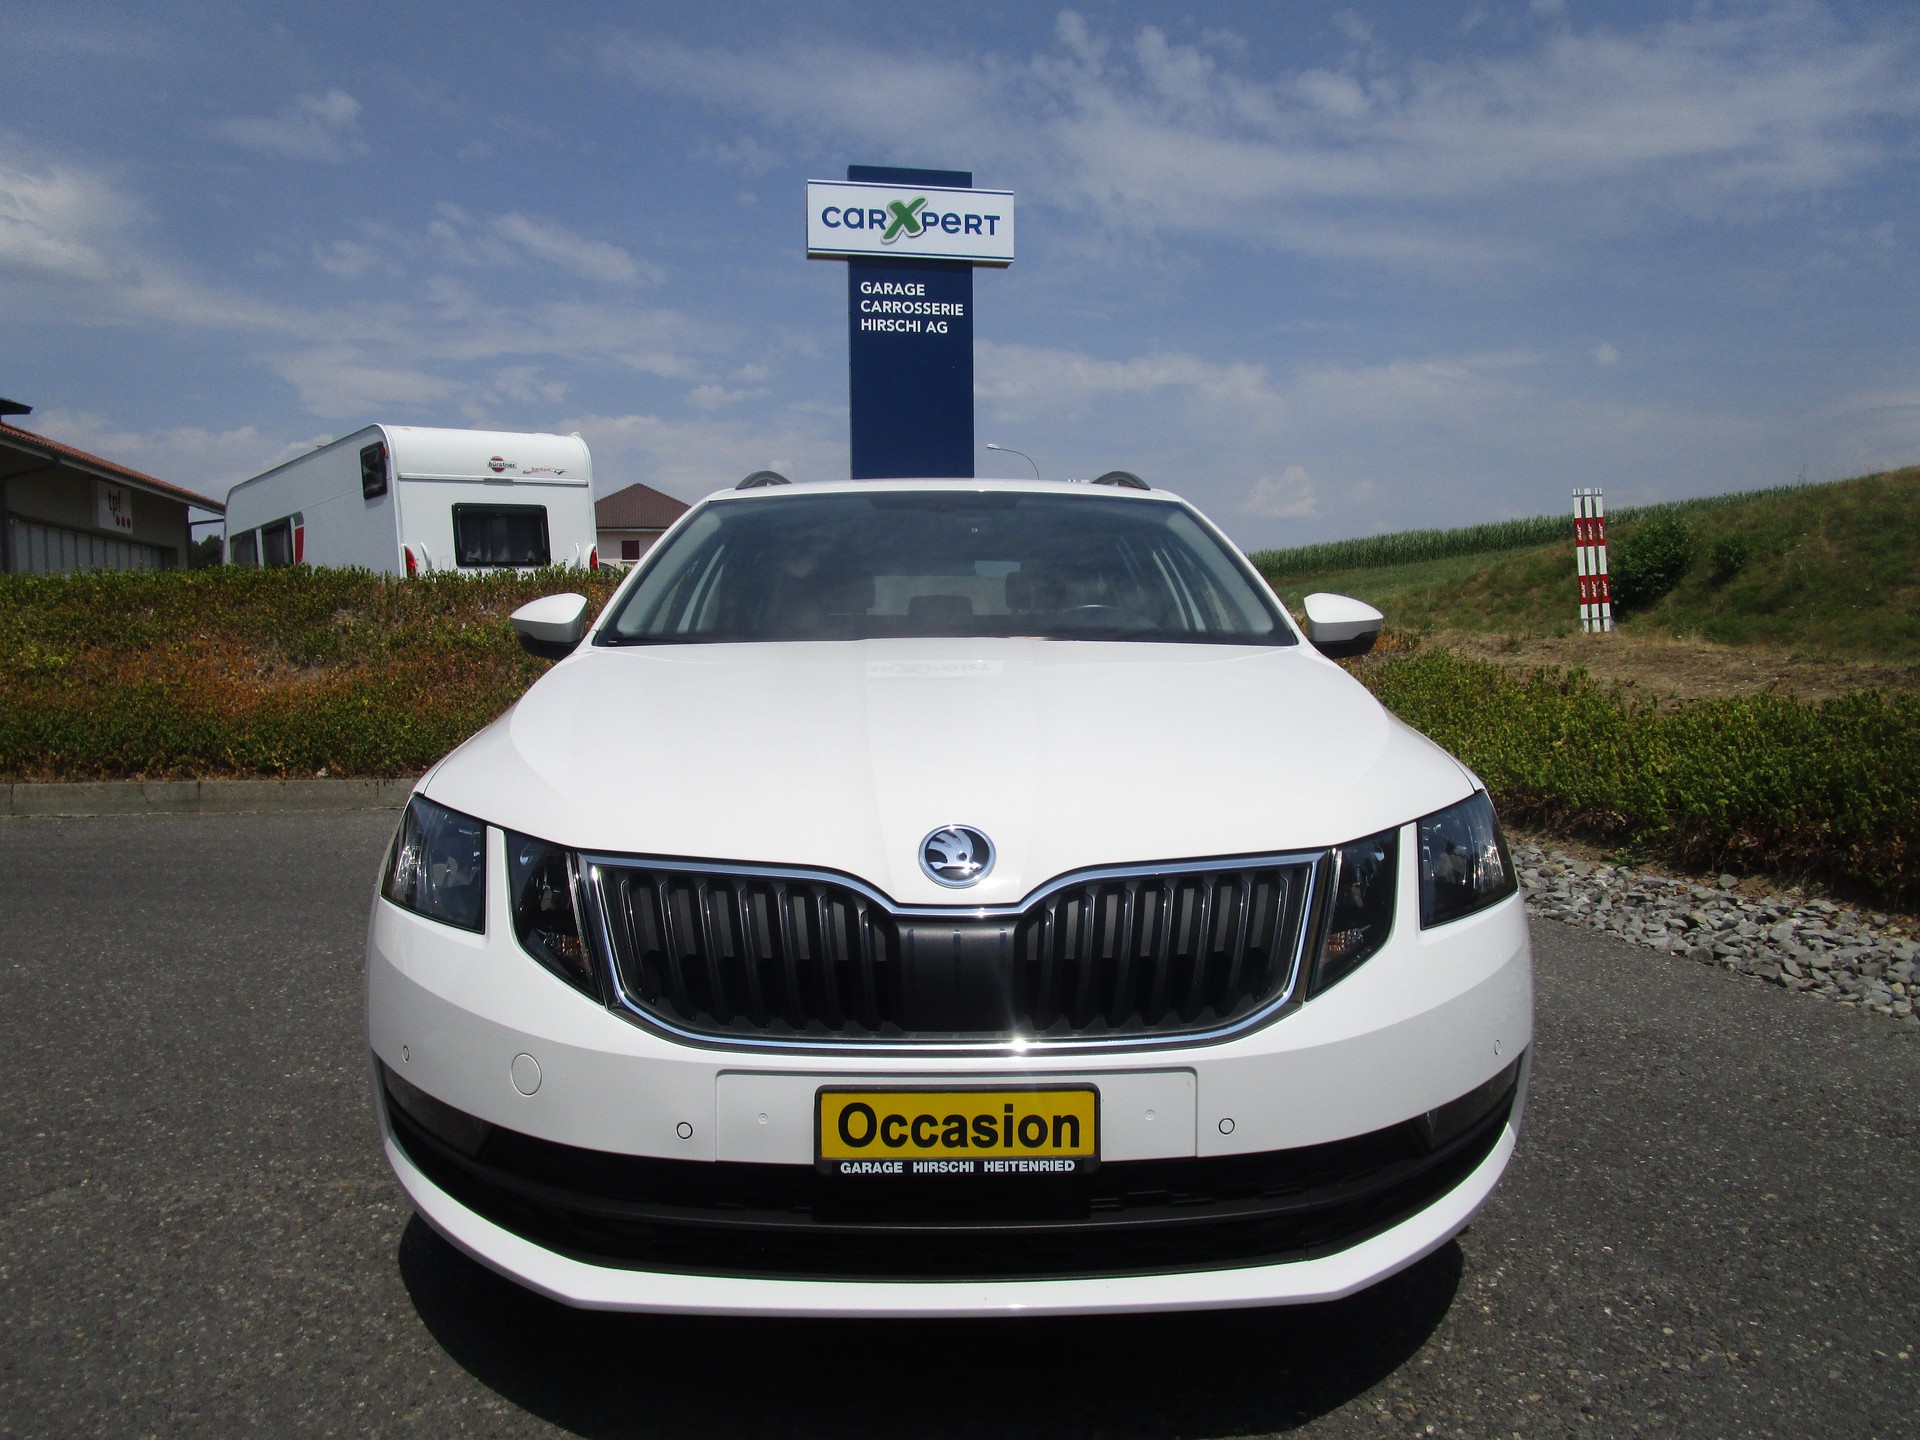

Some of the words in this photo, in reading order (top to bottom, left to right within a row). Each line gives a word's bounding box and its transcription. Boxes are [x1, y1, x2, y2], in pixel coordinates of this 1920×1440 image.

[860, 282, 925, 296] GARAGE
[860, 301, 964, 316] CARROSSERIE
[861, 319, 921, 332] HIRSCHI
[925, 321, 948, 334] AG
[108, 490, 121, 517] tpf
[838, 1102, 1080, 1148] Occasion
[840, 1162, 903, 1174] GARAGE
[913, 1161, 974, 1173] HIRSCHI
[984, 1160, 1075, 1173] HEITENRIED
